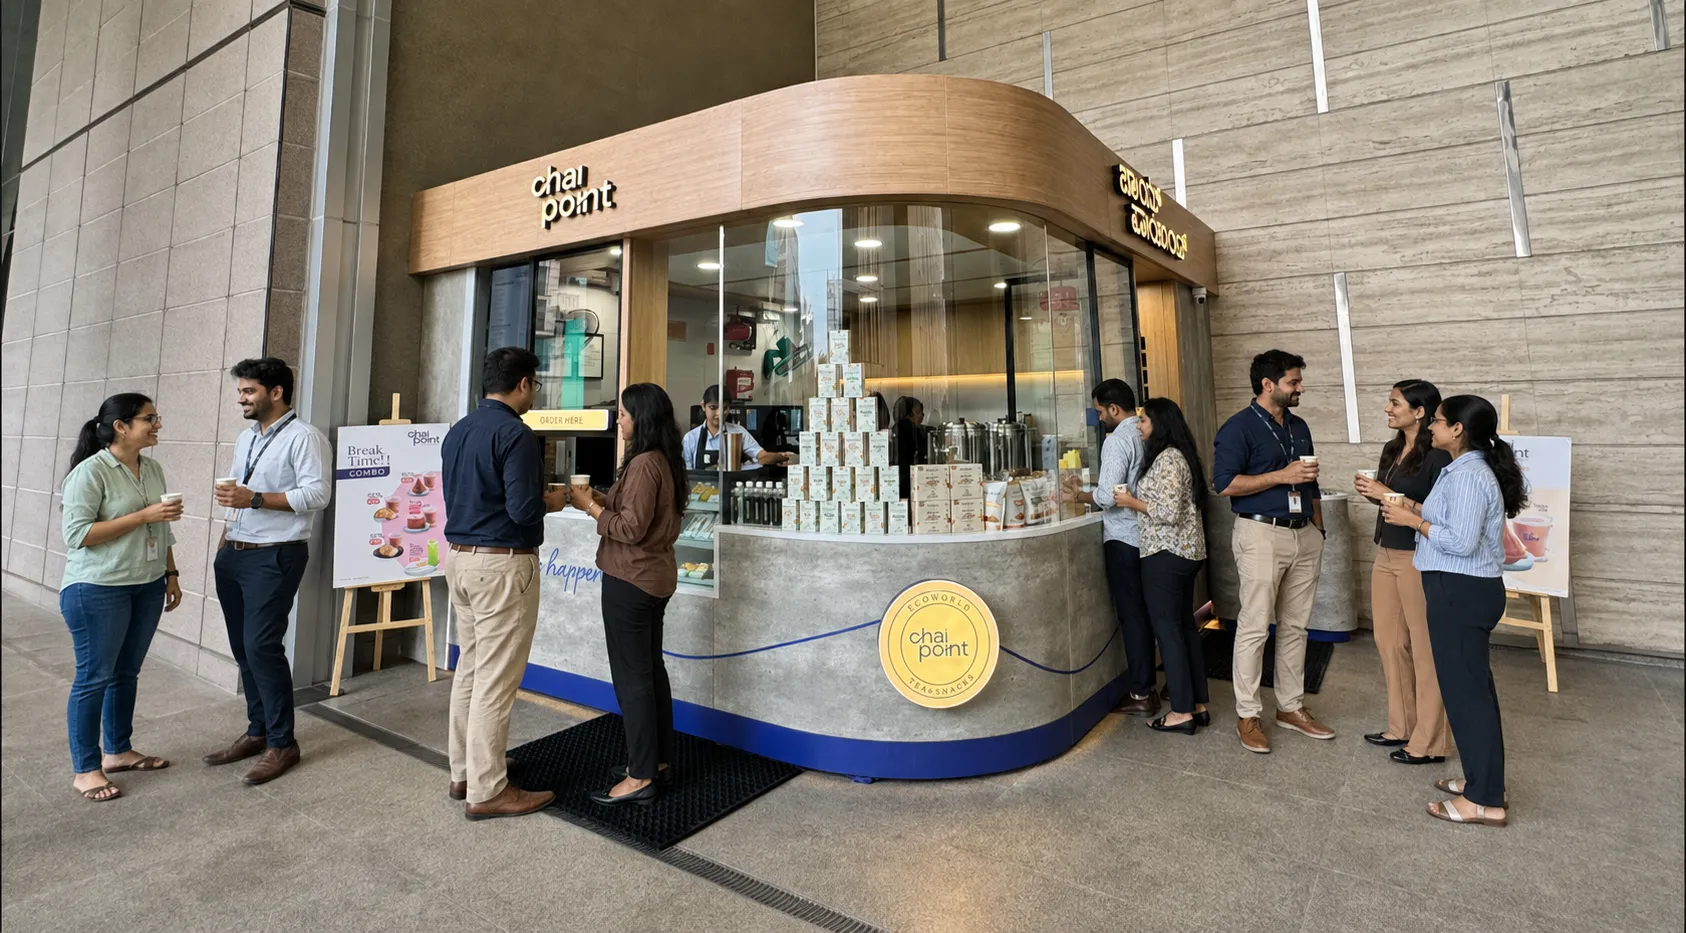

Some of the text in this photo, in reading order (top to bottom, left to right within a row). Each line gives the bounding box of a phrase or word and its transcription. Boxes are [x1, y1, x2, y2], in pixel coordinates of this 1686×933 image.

[531, 165, 586, 198] chai
[541, 180, 613, 229] point
[539, 416, 584, 425] ORDER HERE
[407, 429, 430, 439] chai
[413, 436, 440, 446] point
[347, 444, 383, 456] Break
[349, 468, 385, 478] COMBO
[907, 593, 971, 612] ECOWORLD
[909, 628, 948, 644] chai
[919, 641, 969, 663] point
